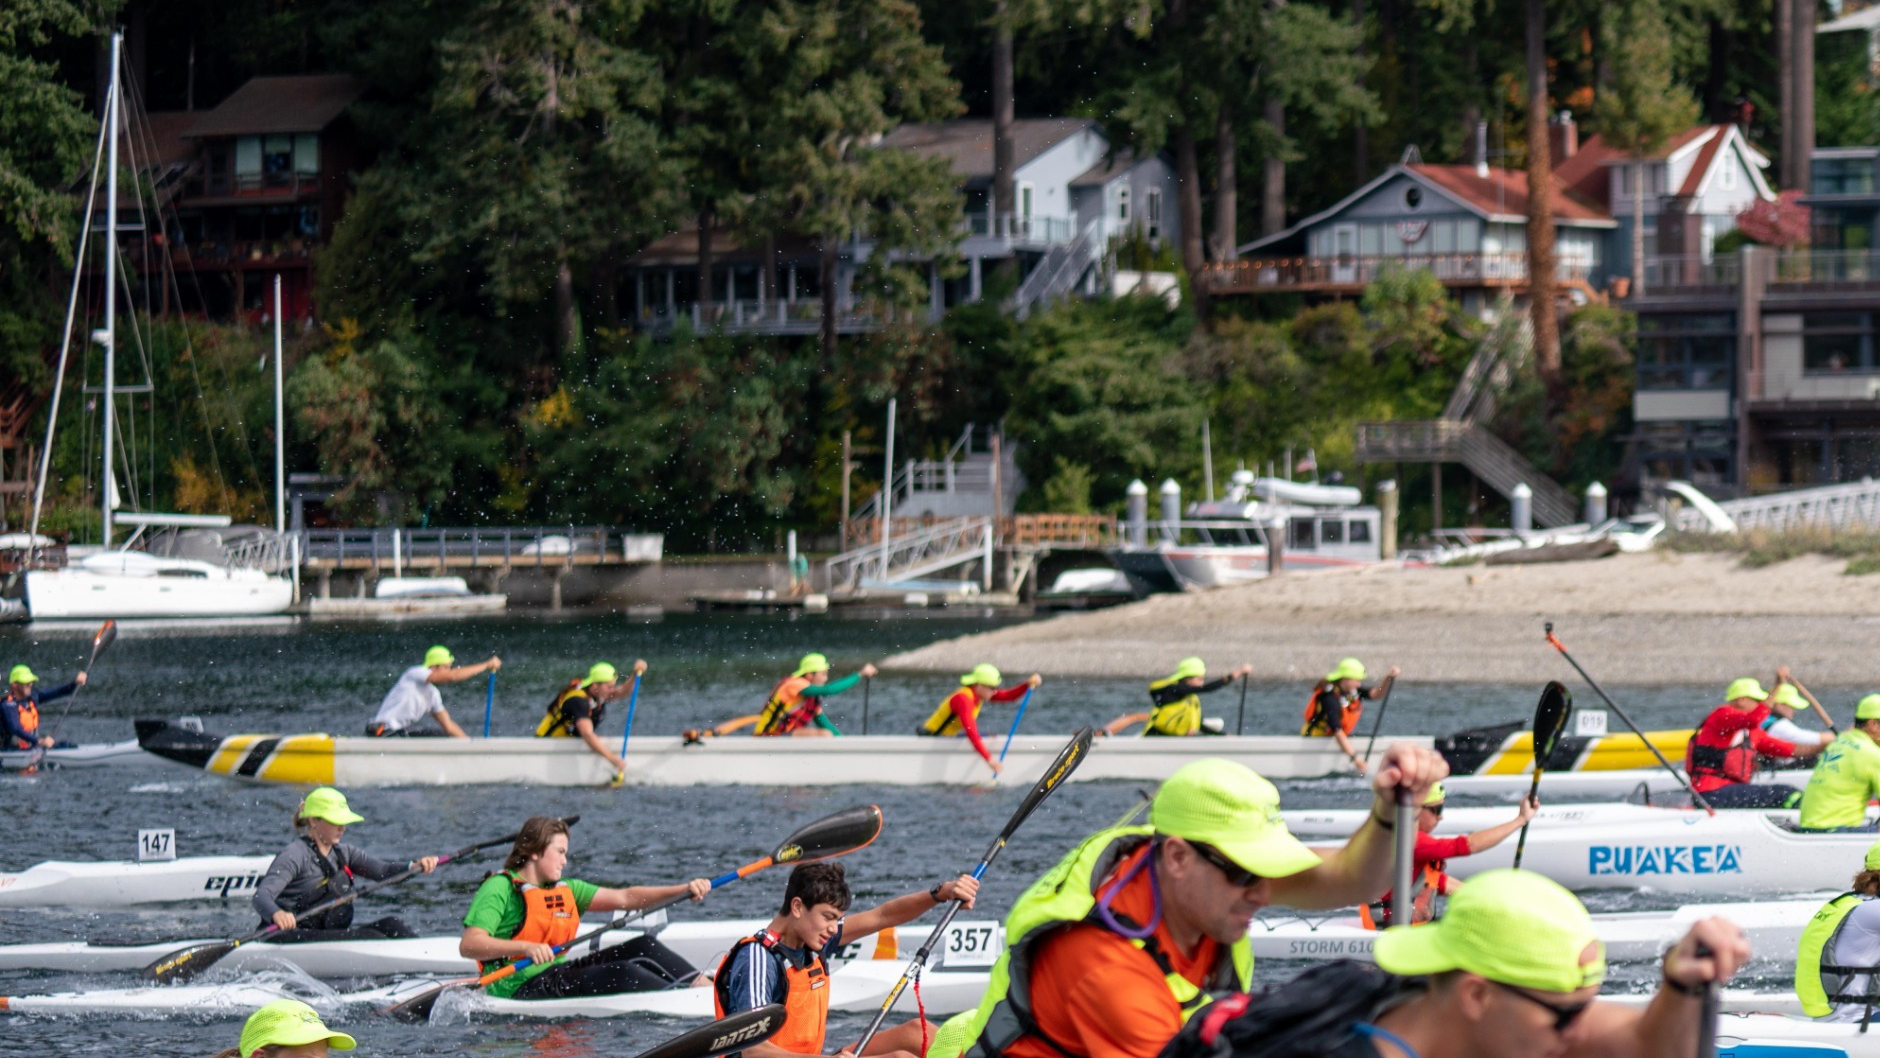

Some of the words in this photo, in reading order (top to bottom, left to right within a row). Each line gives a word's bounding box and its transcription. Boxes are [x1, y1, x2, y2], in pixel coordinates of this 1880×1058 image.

[142, 833, 170, 853] 147
[1588, 845, 1742, 875] PUAKEA
[950, 928, 993, 952] 357
[1290, 940, 1344, 954] STORM
